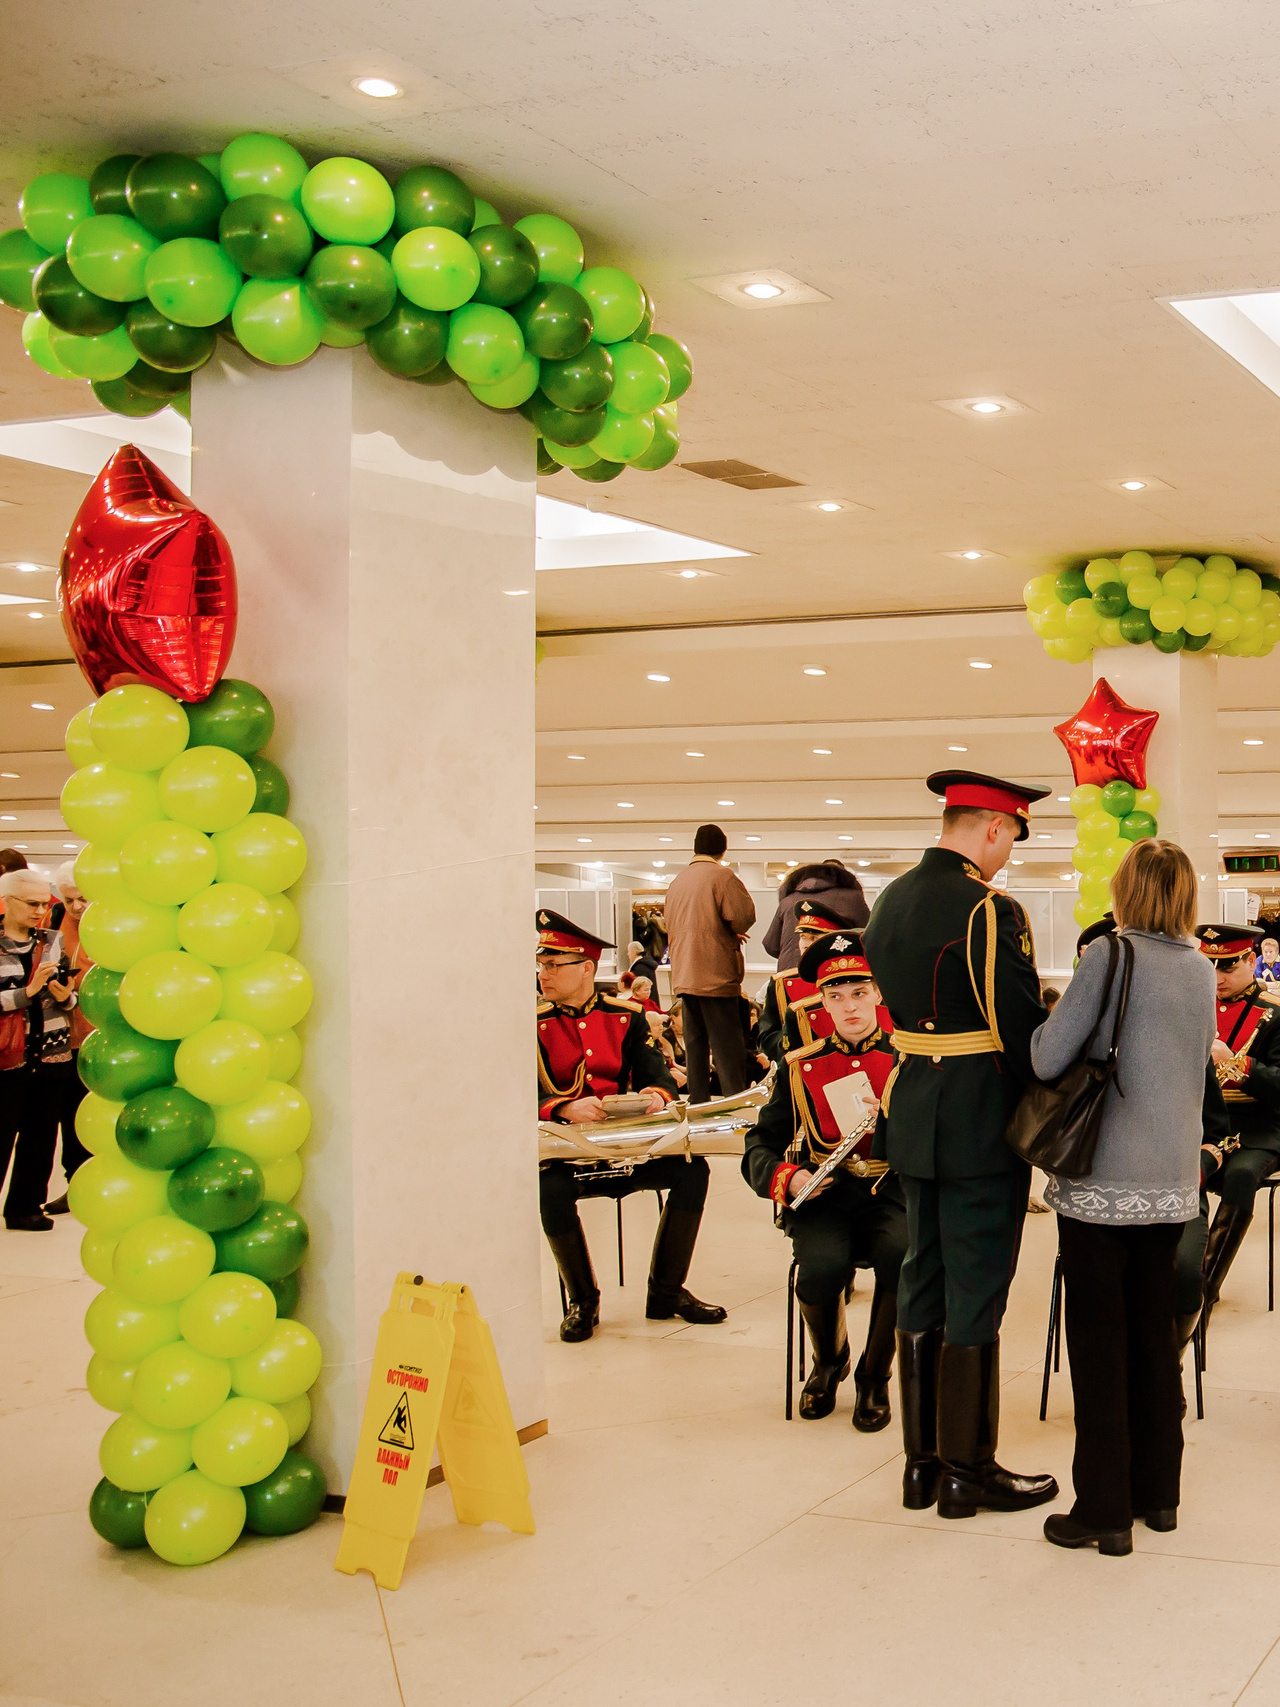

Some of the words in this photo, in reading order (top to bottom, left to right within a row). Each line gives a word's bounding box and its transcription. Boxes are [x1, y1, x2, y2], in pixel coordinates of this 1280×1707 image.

[387, 1369, 428, 1393] ОСТОРОЖНО
[377, 1447, 410, 1471] ВЛАЖНЫЙ
[382, 1468, 398, 1487] ПОЛ
